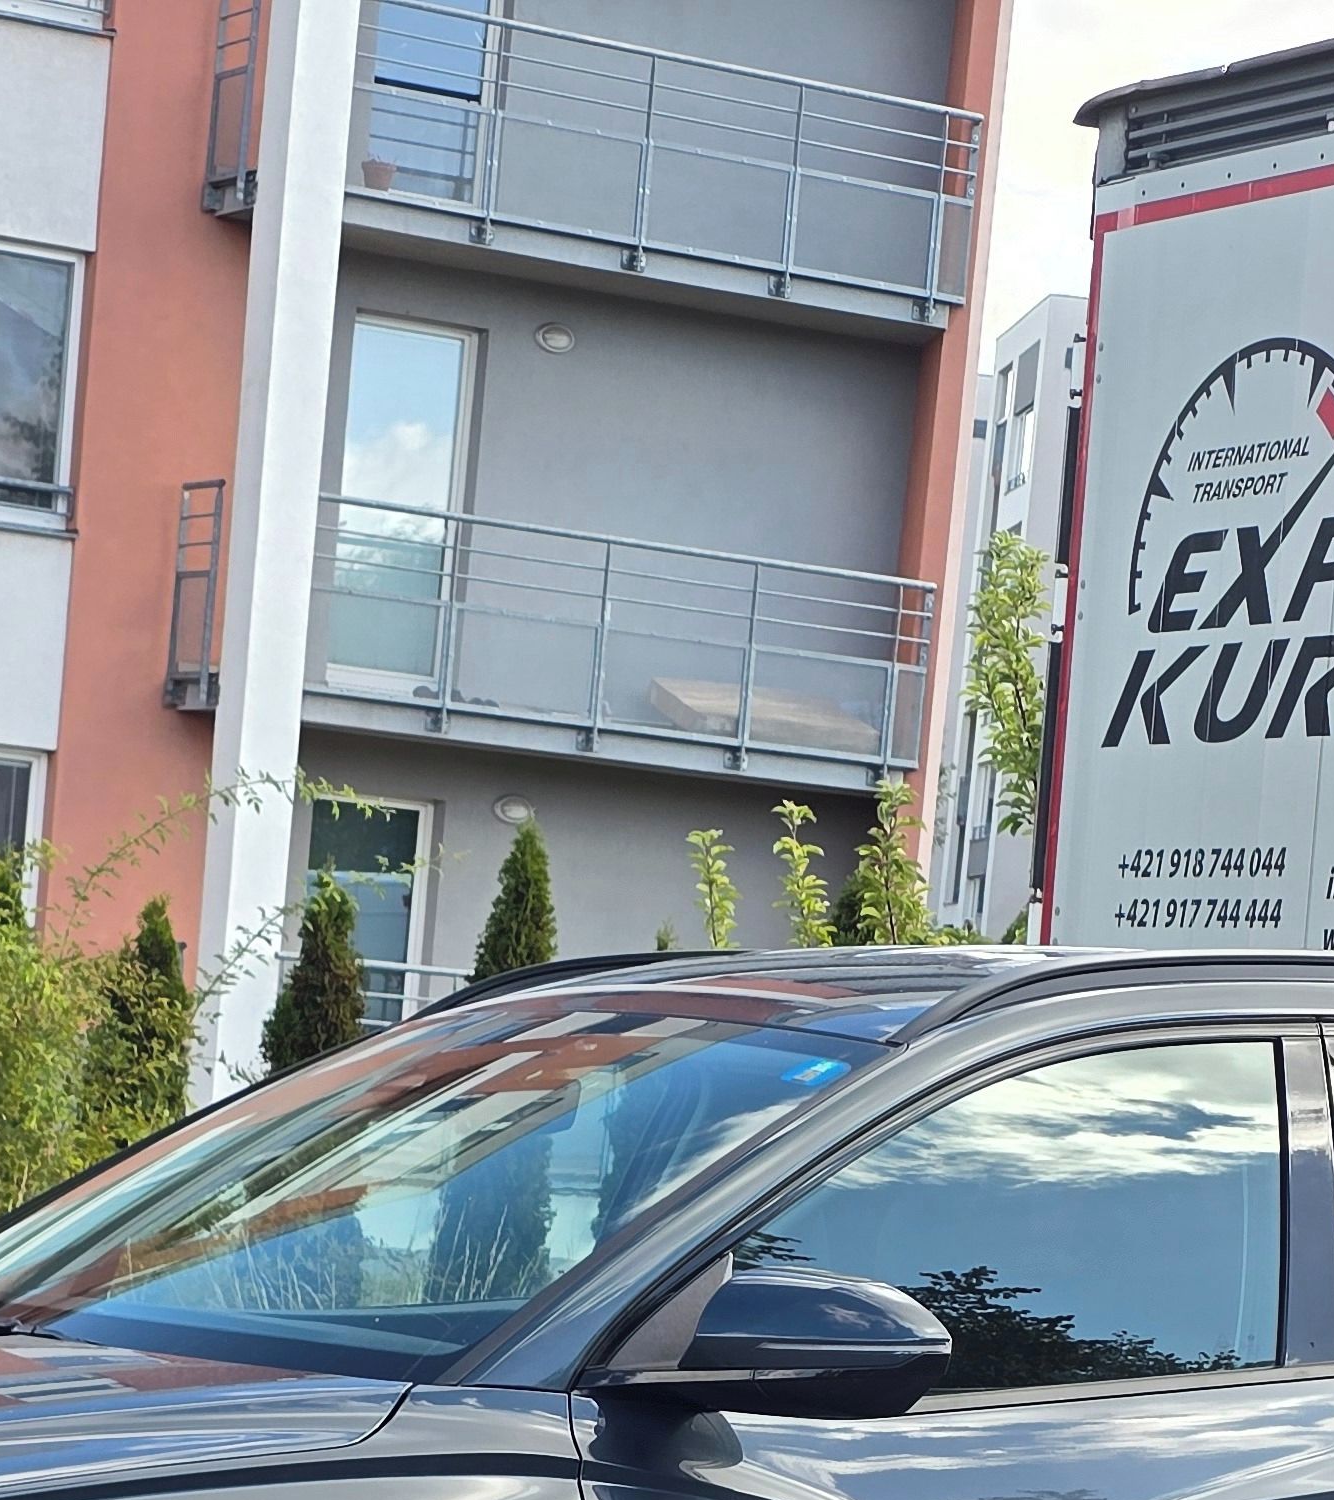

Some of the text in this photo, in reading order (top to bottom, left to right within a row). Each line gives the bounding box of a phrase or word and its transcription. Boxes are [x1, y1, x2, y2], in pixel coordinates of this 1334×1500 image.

[1186, 435, 1310, 473] INTERNATIONAL
[1192, 471, 1289, 504] TRANSPORT
[1118, 846, 1287, 879] +421 918 744 044
[1114, 898, 1283, 929] +421 917 744 444
